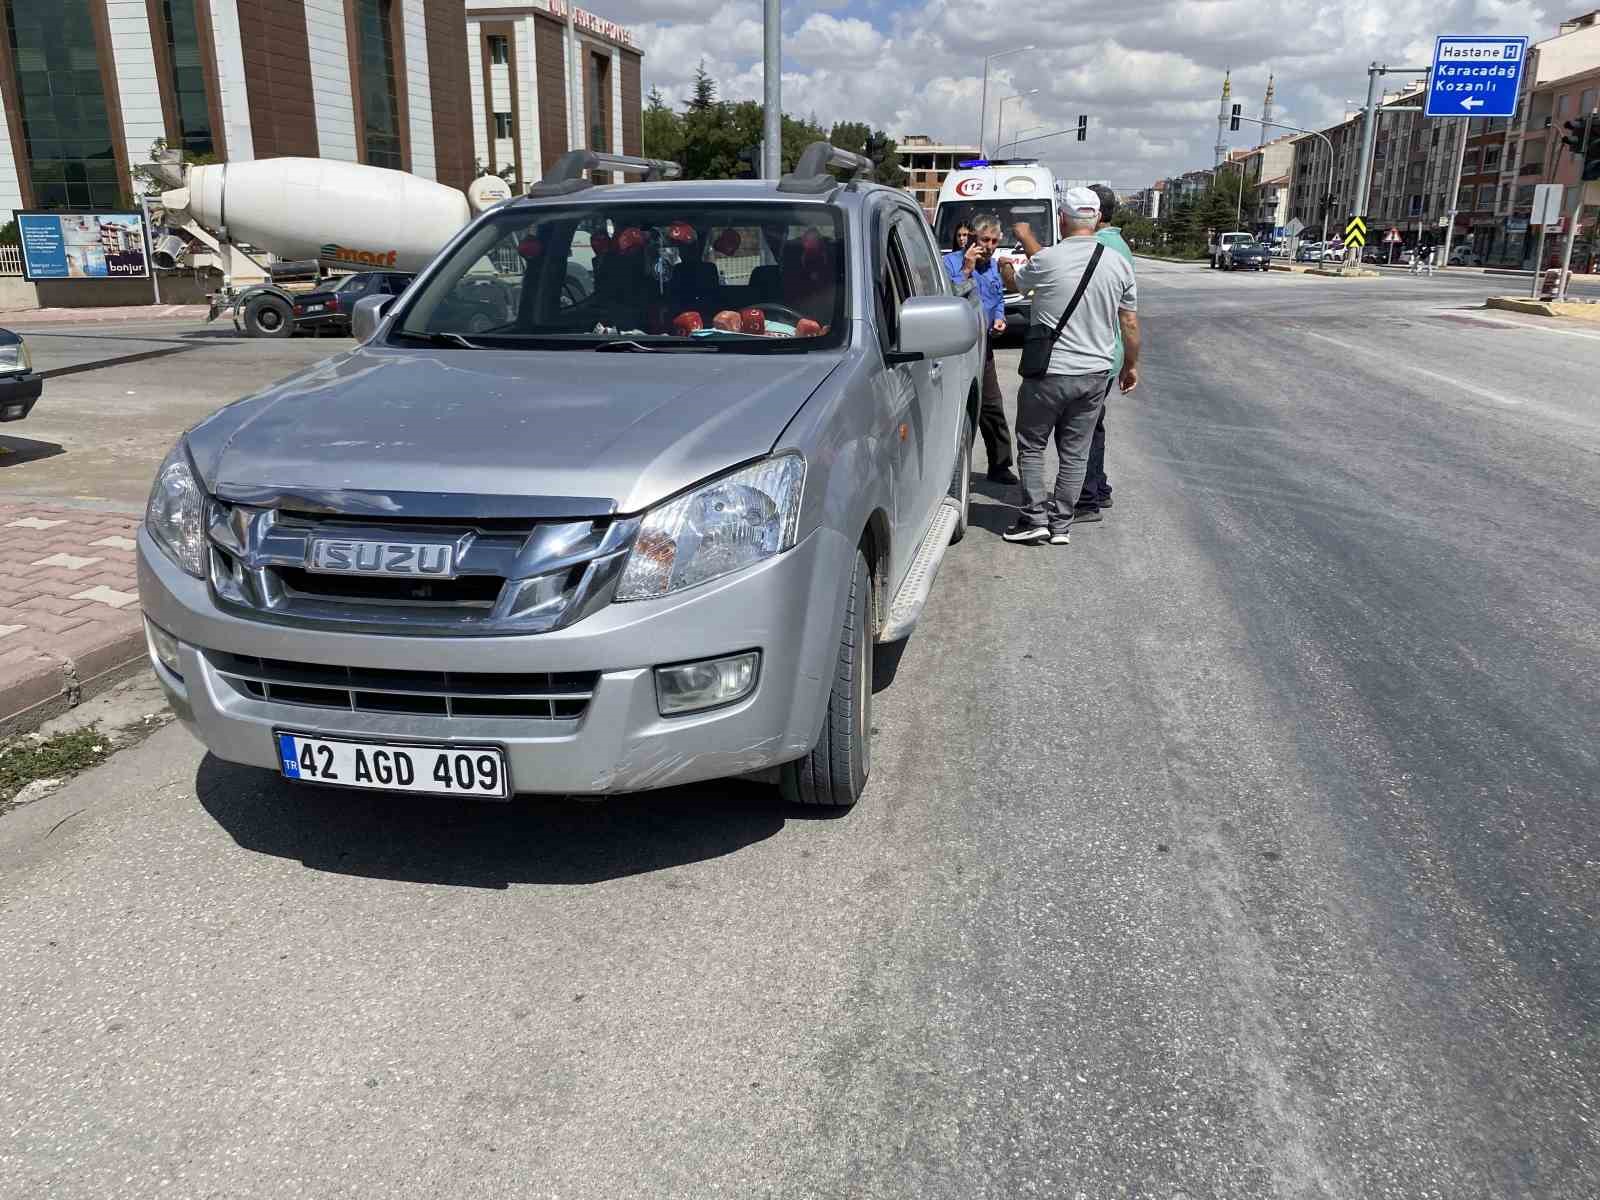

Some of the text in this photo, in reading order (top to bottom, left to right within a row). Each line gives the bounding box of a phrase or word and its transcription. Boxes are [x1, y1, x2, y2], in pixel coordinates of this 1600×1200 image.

[1443, 46, 1518, 58] Hastane H
[1438, 64, 1516, 78] Karacadağ
[1435, 80, 1497, 92] Kozanlı
[964, 183, 984, 191] 112
[109, 260, 144, 274] bonjur
[313, 540, 451, 574] ISUZU
[284, 759, 299, 771] TR
[299, 742, 498, 791] 42 AGD 409
